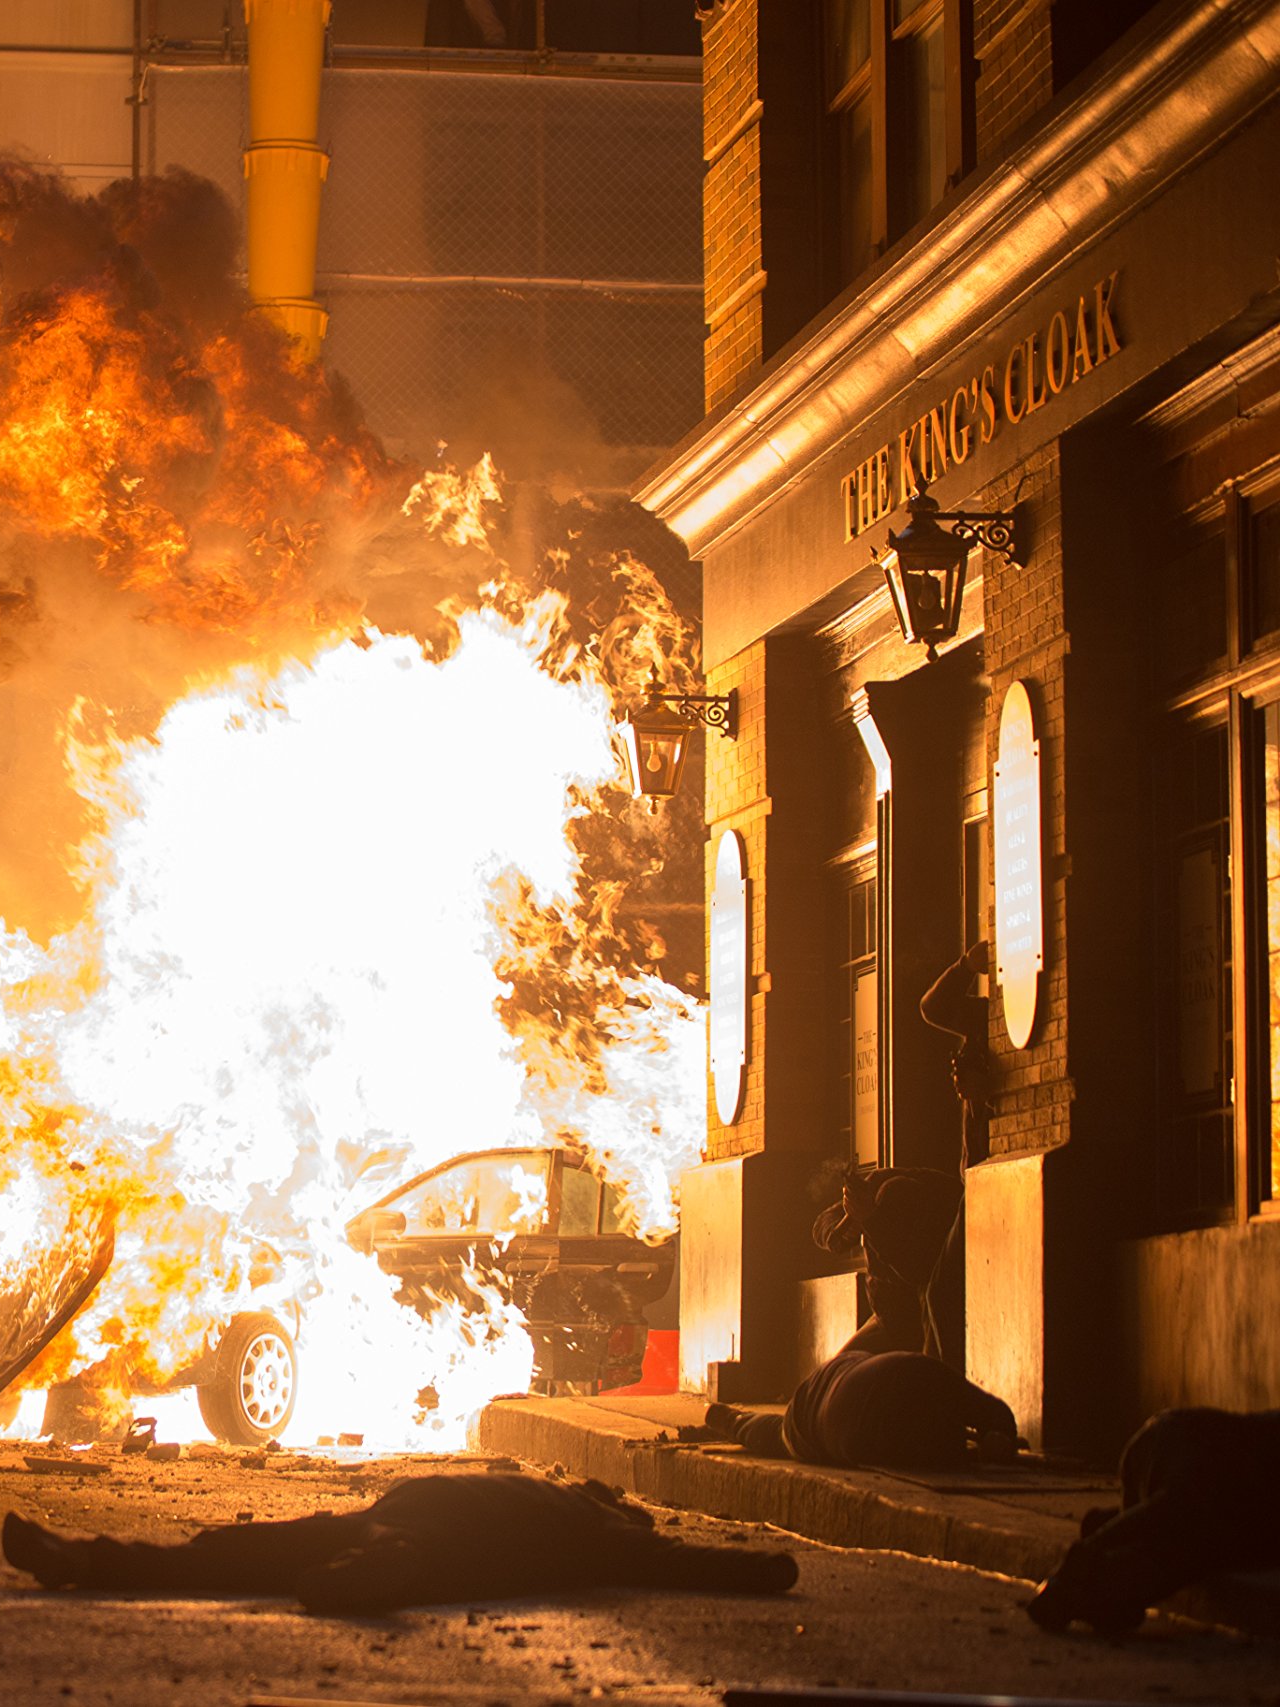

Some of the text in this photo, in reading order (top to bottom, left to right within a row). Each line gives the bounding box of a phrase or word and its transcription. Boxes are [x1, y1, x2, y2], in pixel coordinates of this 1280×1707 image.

[841, 269, 1123, 545] THE KING'S CLOAK
